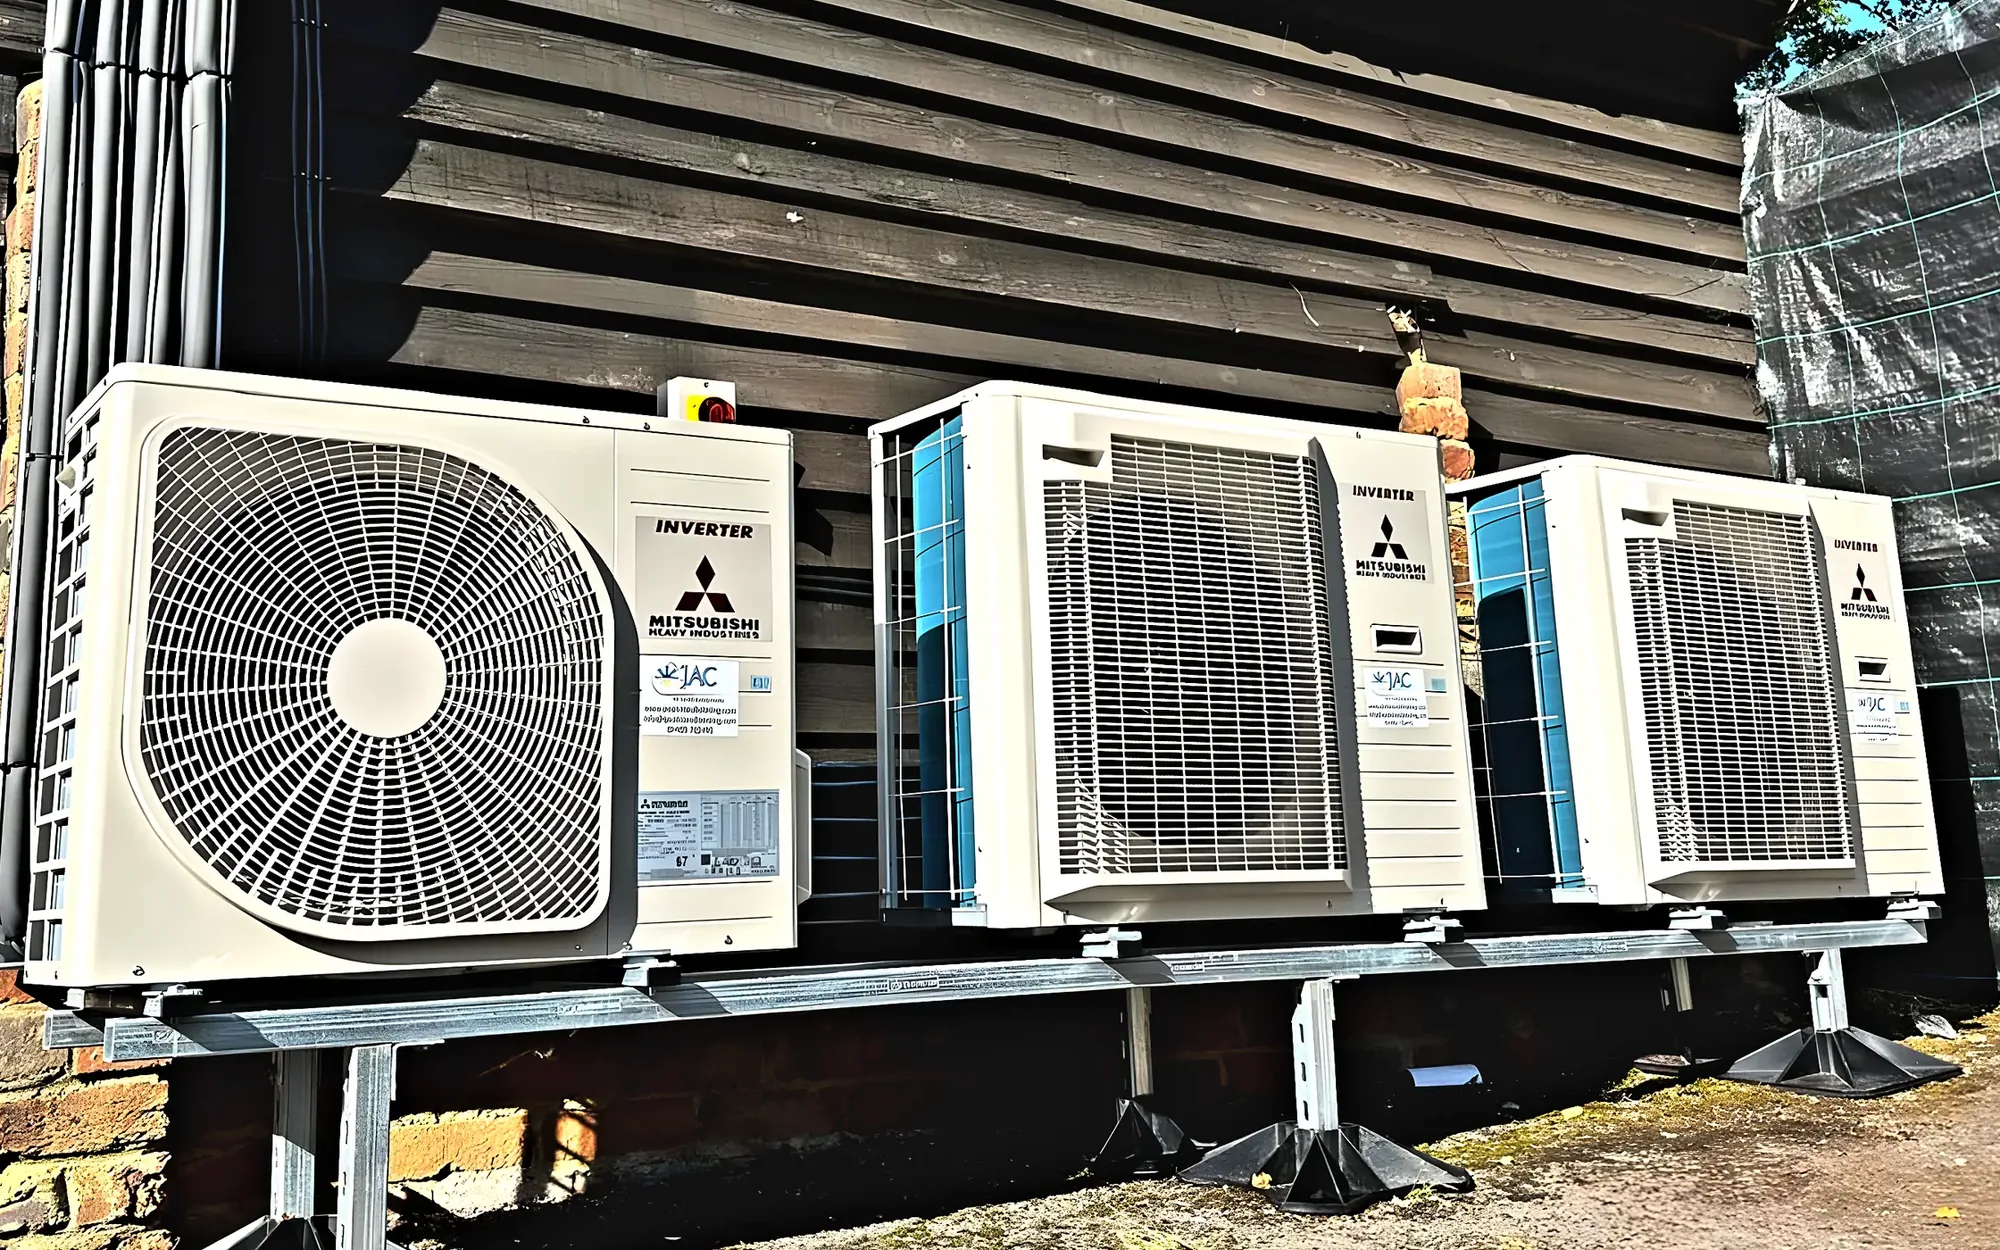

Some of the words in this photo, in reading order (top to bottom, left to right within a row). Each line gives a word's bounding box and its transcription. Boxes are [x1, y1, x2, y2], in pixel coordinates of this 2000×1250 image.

[655, 519, 753, 538] INVERTER
[649, 615, 760, 631] MITSUBISHI
[649, 628, 687, 637] HEAVY
[680, 665, 717, 689] JAC
